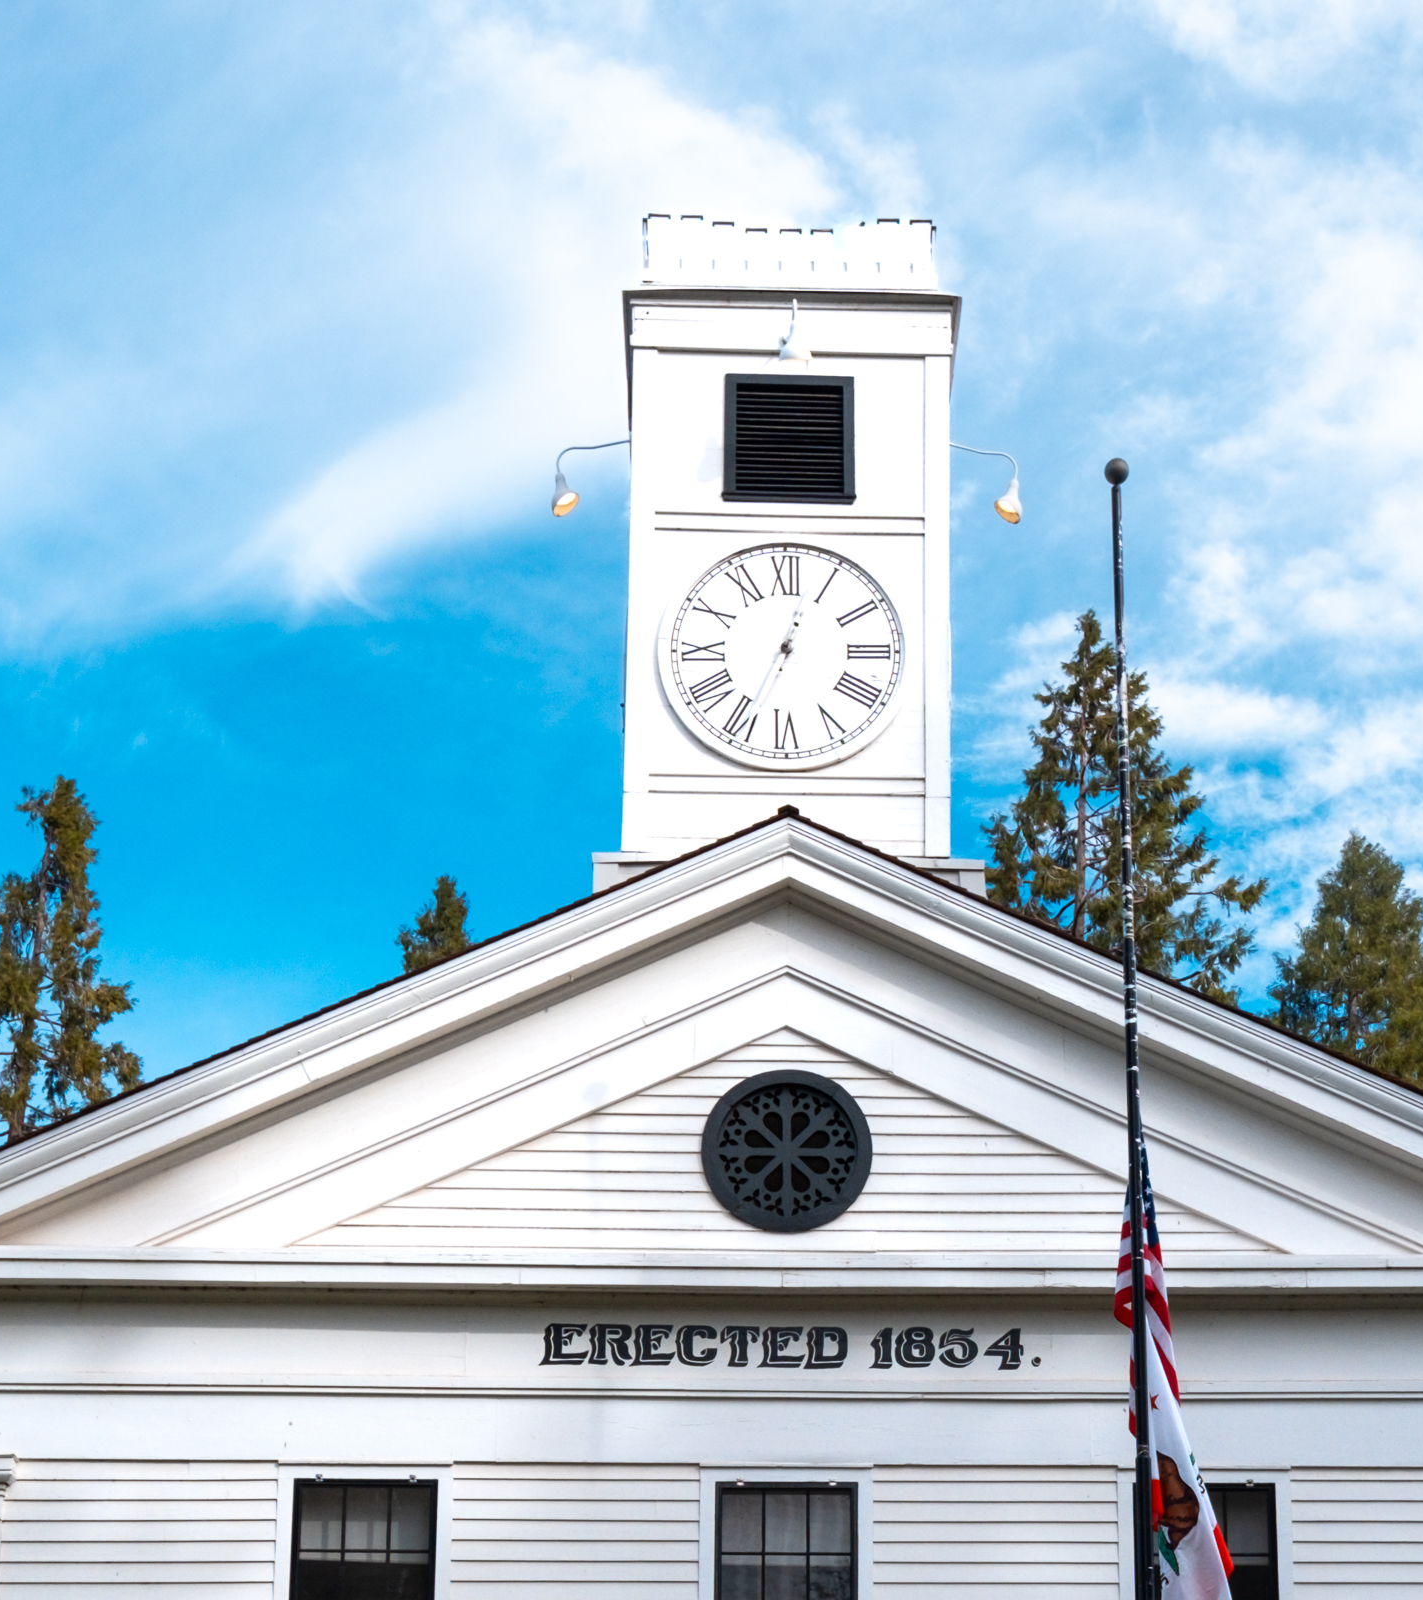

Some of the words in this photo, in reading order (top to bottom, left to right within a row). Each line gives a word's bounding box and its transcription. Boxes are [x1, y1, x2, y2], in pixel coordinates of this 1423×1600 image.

[771, 555, 801, 597] XII
[538, 1322, 849, 1370] ERECTED
[869, 1326, 1043, 1371] 1854.
